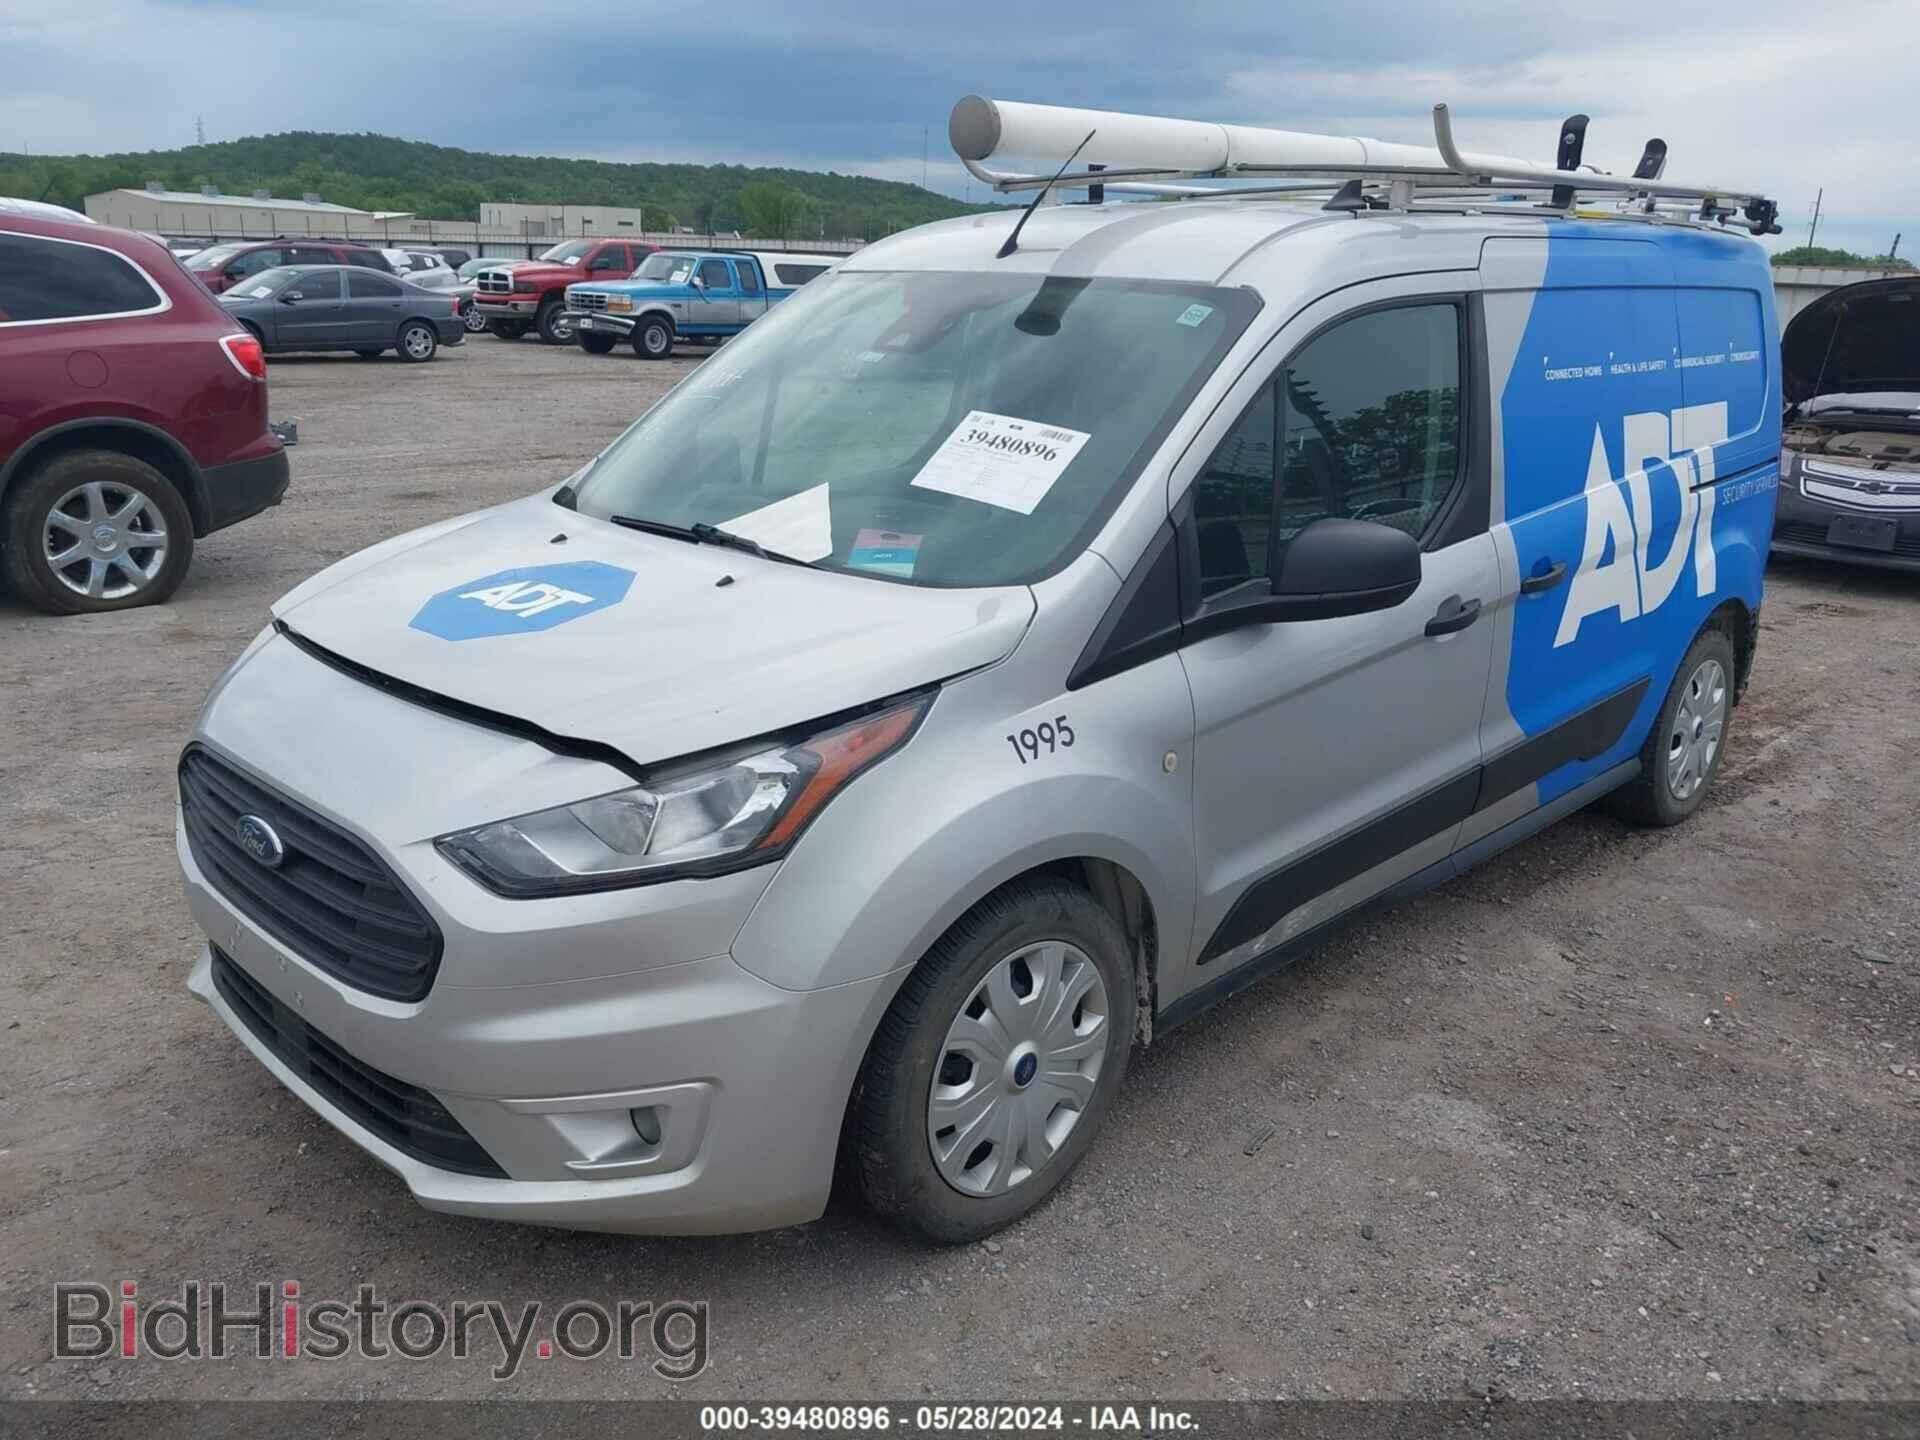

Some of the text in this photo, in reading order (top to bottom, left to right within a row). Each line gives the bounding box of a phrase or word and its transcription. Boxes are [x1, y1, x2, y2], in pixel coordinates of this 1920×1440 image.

[1545, 366, 1602, 381] CONNECTED HOME
[1611, 363, 1632, 374] HEALTH
[1638, 361, 1649, 371] LIFE
[1649, 360, 1667, 370] SAFETY
[959, 428, 1058, 462] 39480896
[1552, 400, 1729, 648] ADT
[458, 580, 596, 618] ADT
[1006, 714, 1075, 764] 1995
